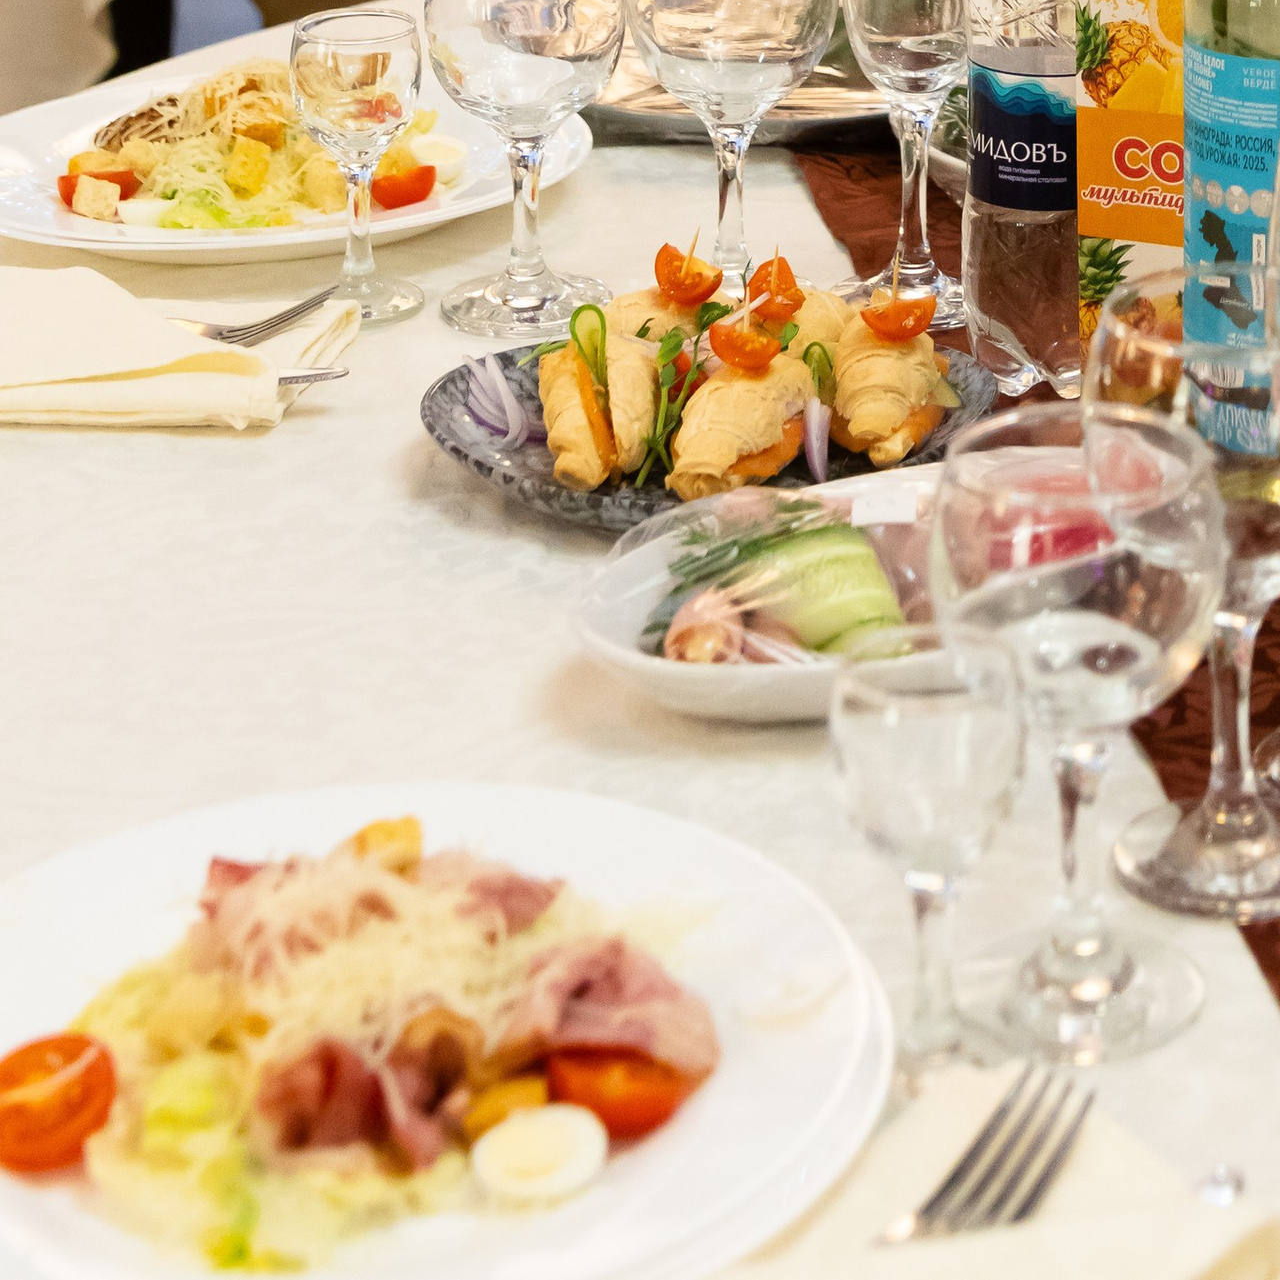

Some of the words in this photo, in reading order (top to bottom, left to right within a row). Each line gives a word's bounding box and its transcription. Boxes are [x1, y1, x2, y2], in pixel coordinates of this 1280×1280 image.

[1242, 68, 1277, 77] VERDE
[1243, 78, 1276, 91] ВЕРДЕ
[969, 127, 1068, 164] МИДОВЪ
[1235, 134, 1276, 158] РОССИЯ,
[1112, 137, 1184, 186] СО
[1242, 153, 1269, 172] 2025.
